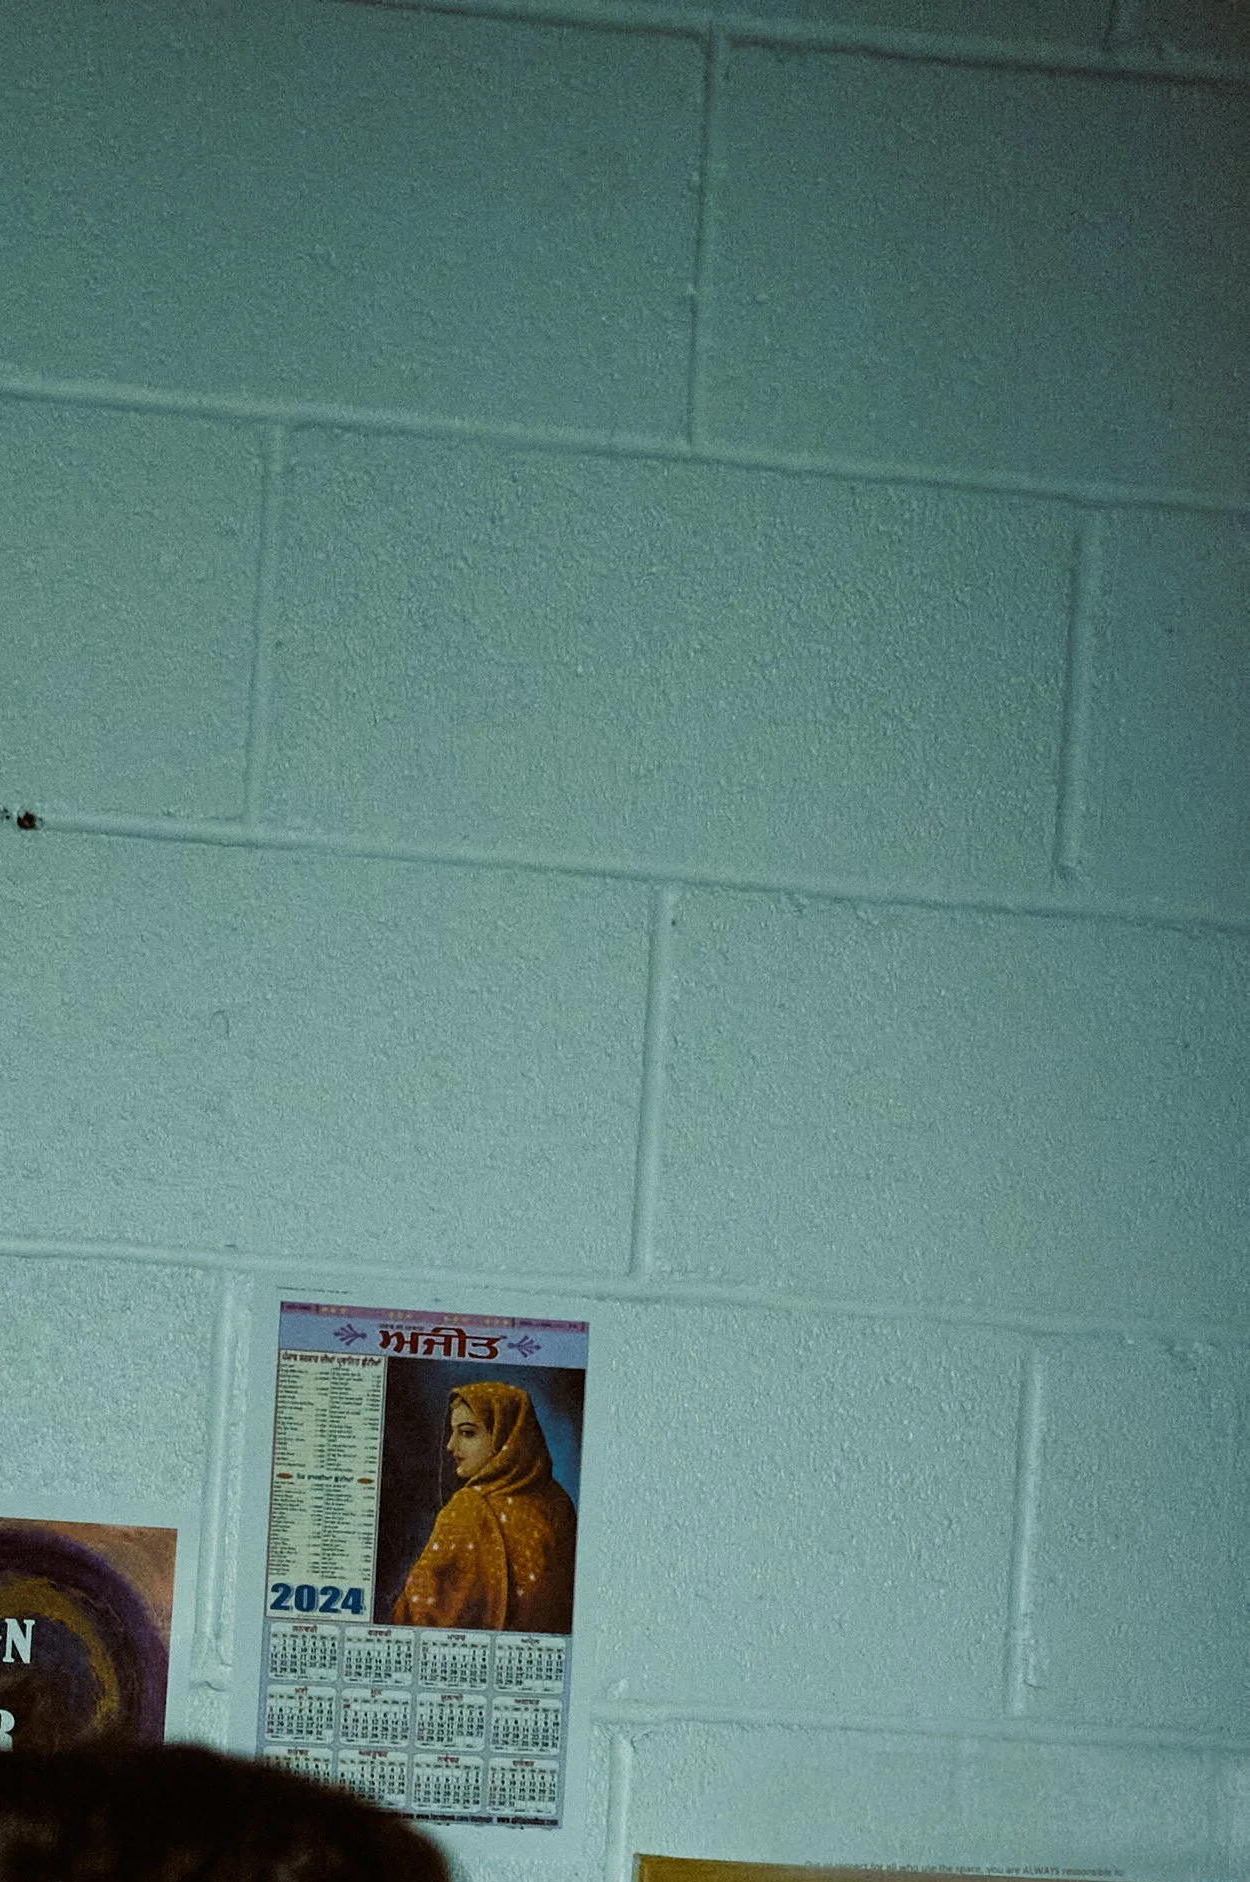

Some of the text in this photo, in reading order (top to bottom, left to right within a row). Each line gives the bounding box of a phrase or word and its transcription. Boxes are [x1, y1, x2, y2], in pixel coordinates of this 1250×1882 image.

[378, 1327, 509, 1359] ਅਜੀਤ
[270, 1582, 365, 1616] 2024
[939, 1864, 953, 1872] the
[956, 1867, 983, 1876] space,
[987, 1867, 1003, 1875] you
[1006, 1867, 1020, 1875] are
[1023, 1866, 1060, 1876] ALWAYS
[1062, 1867, 1112, 1877] responsible
